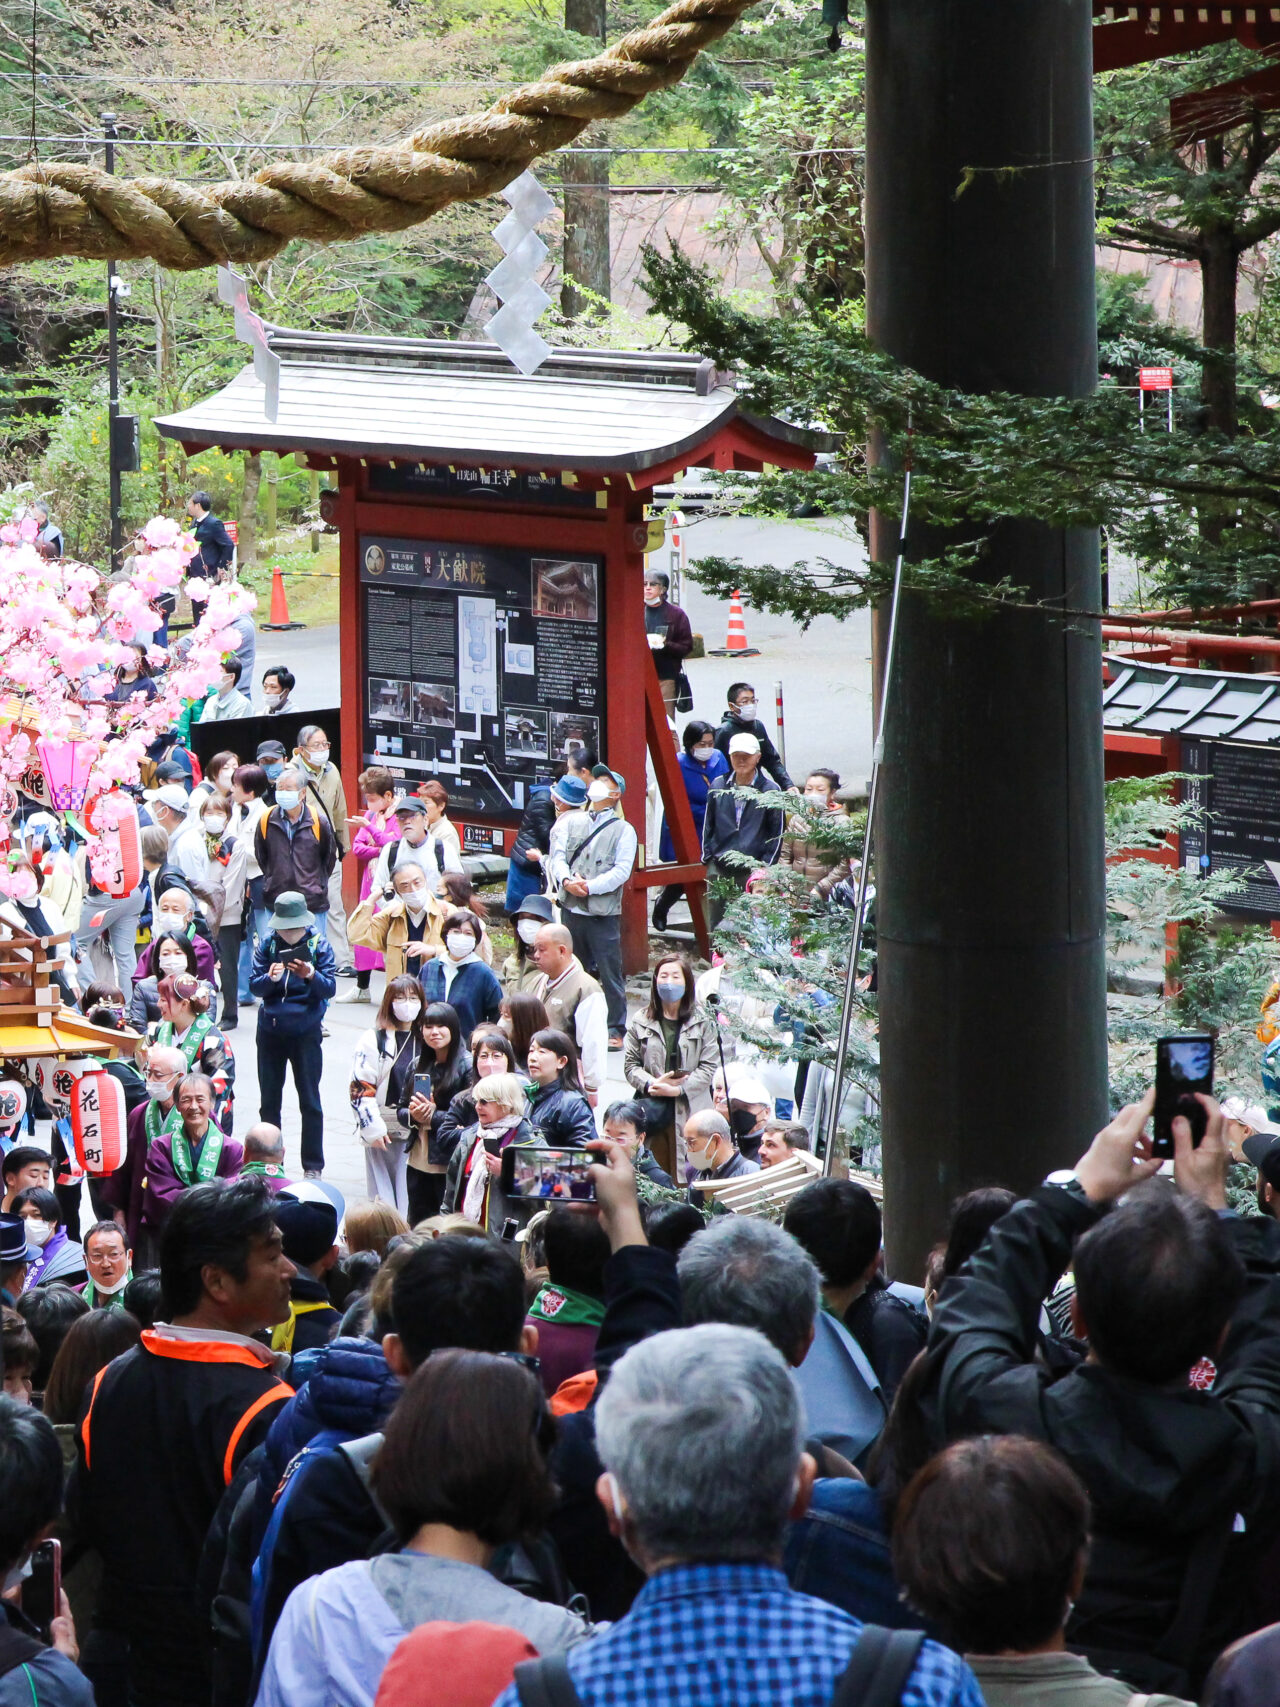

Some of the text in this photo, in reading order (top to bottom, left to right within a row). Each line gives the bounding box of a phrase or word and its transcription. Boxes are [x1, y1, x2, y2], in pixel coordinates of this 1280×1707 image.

[54, 1071, 73, 1095] 花
[79, 1088, 102, 1164] 花石町
